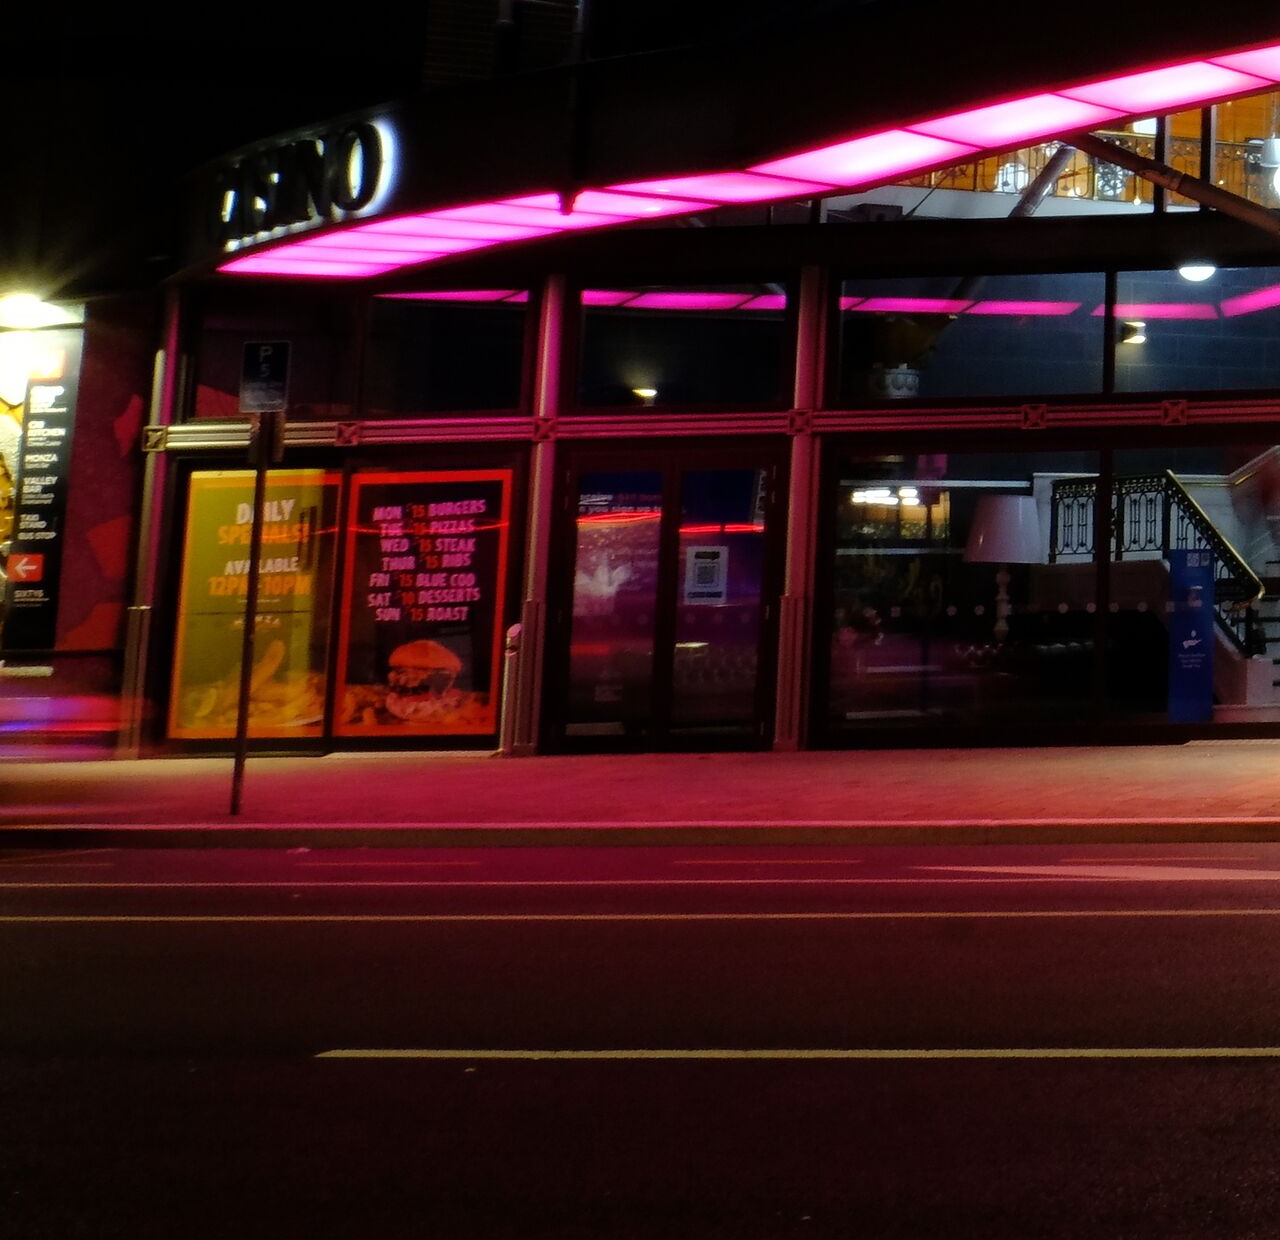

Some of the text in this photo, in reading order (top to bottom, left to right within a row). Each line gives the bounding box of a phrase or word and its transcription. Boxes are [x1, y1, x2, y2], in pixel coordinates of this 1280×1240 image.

[259, 345, 273, 362] P
[260, 362, 271, 377] 5
[24, 454, 58, 462] MONZA
[23, 476, 58, 485] VALLEY
[22, 485, 42, 493] BAR
[236, 499, 296, 525] DILY
[373, 506, 402, 521] MON
[428, 499, 487, 517] BURGERS
[218, 523, 310, 545] SPEIALS!
[381, 523, 403, 537] TUE
[430, 519, 475, 534] PIZZAS
[380, 538, 410, 552] WED
[434, 538, 476, 552] STEAK
[441, 553, 472, 568] RIBS
[369, 573, 390, 587] FRI
[415, 573, 448, 587] BLUE
[368, 592, 392, 607] SAT
[418, 587, 481, 604] DESSERTS
[375, 608, 401, 621] SUN
[426, 606, 469, 621] ROAST
